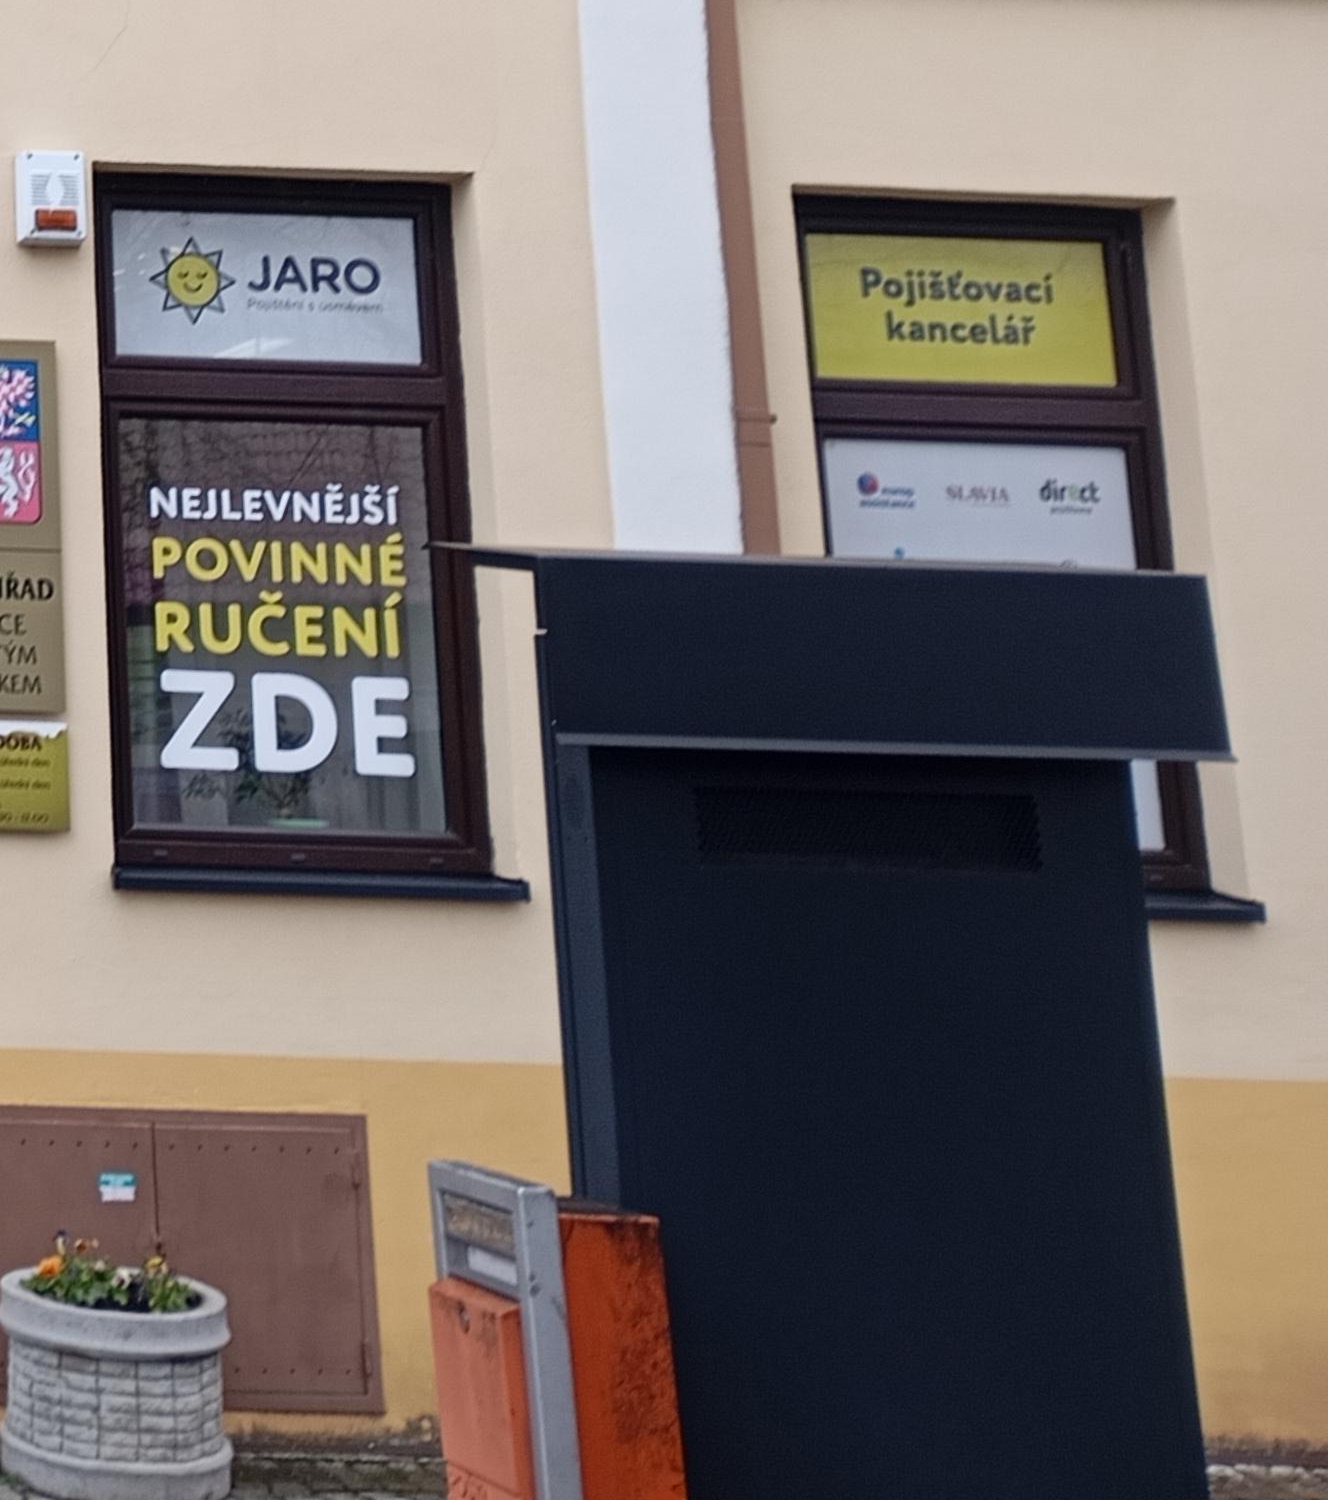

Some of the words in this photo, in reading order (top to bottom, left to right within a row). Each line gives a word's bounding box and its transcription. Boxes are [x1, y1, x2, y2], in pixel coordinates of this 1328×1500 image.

[247, 255, 381, 295] JARO
[859, 267, 1053, 307] Pojišťovací
[886, 311, 1035, 346] kancelář
[150, 484, 399, 526] NEJLEVNĚJŠÍ
[1040, 479, 1100, 503] direct
[152, 532, 407, 588] POVINNÉ
[154, 590, 402, 659] RUČENÍ
[159, 669, 416, 778] ZDE
